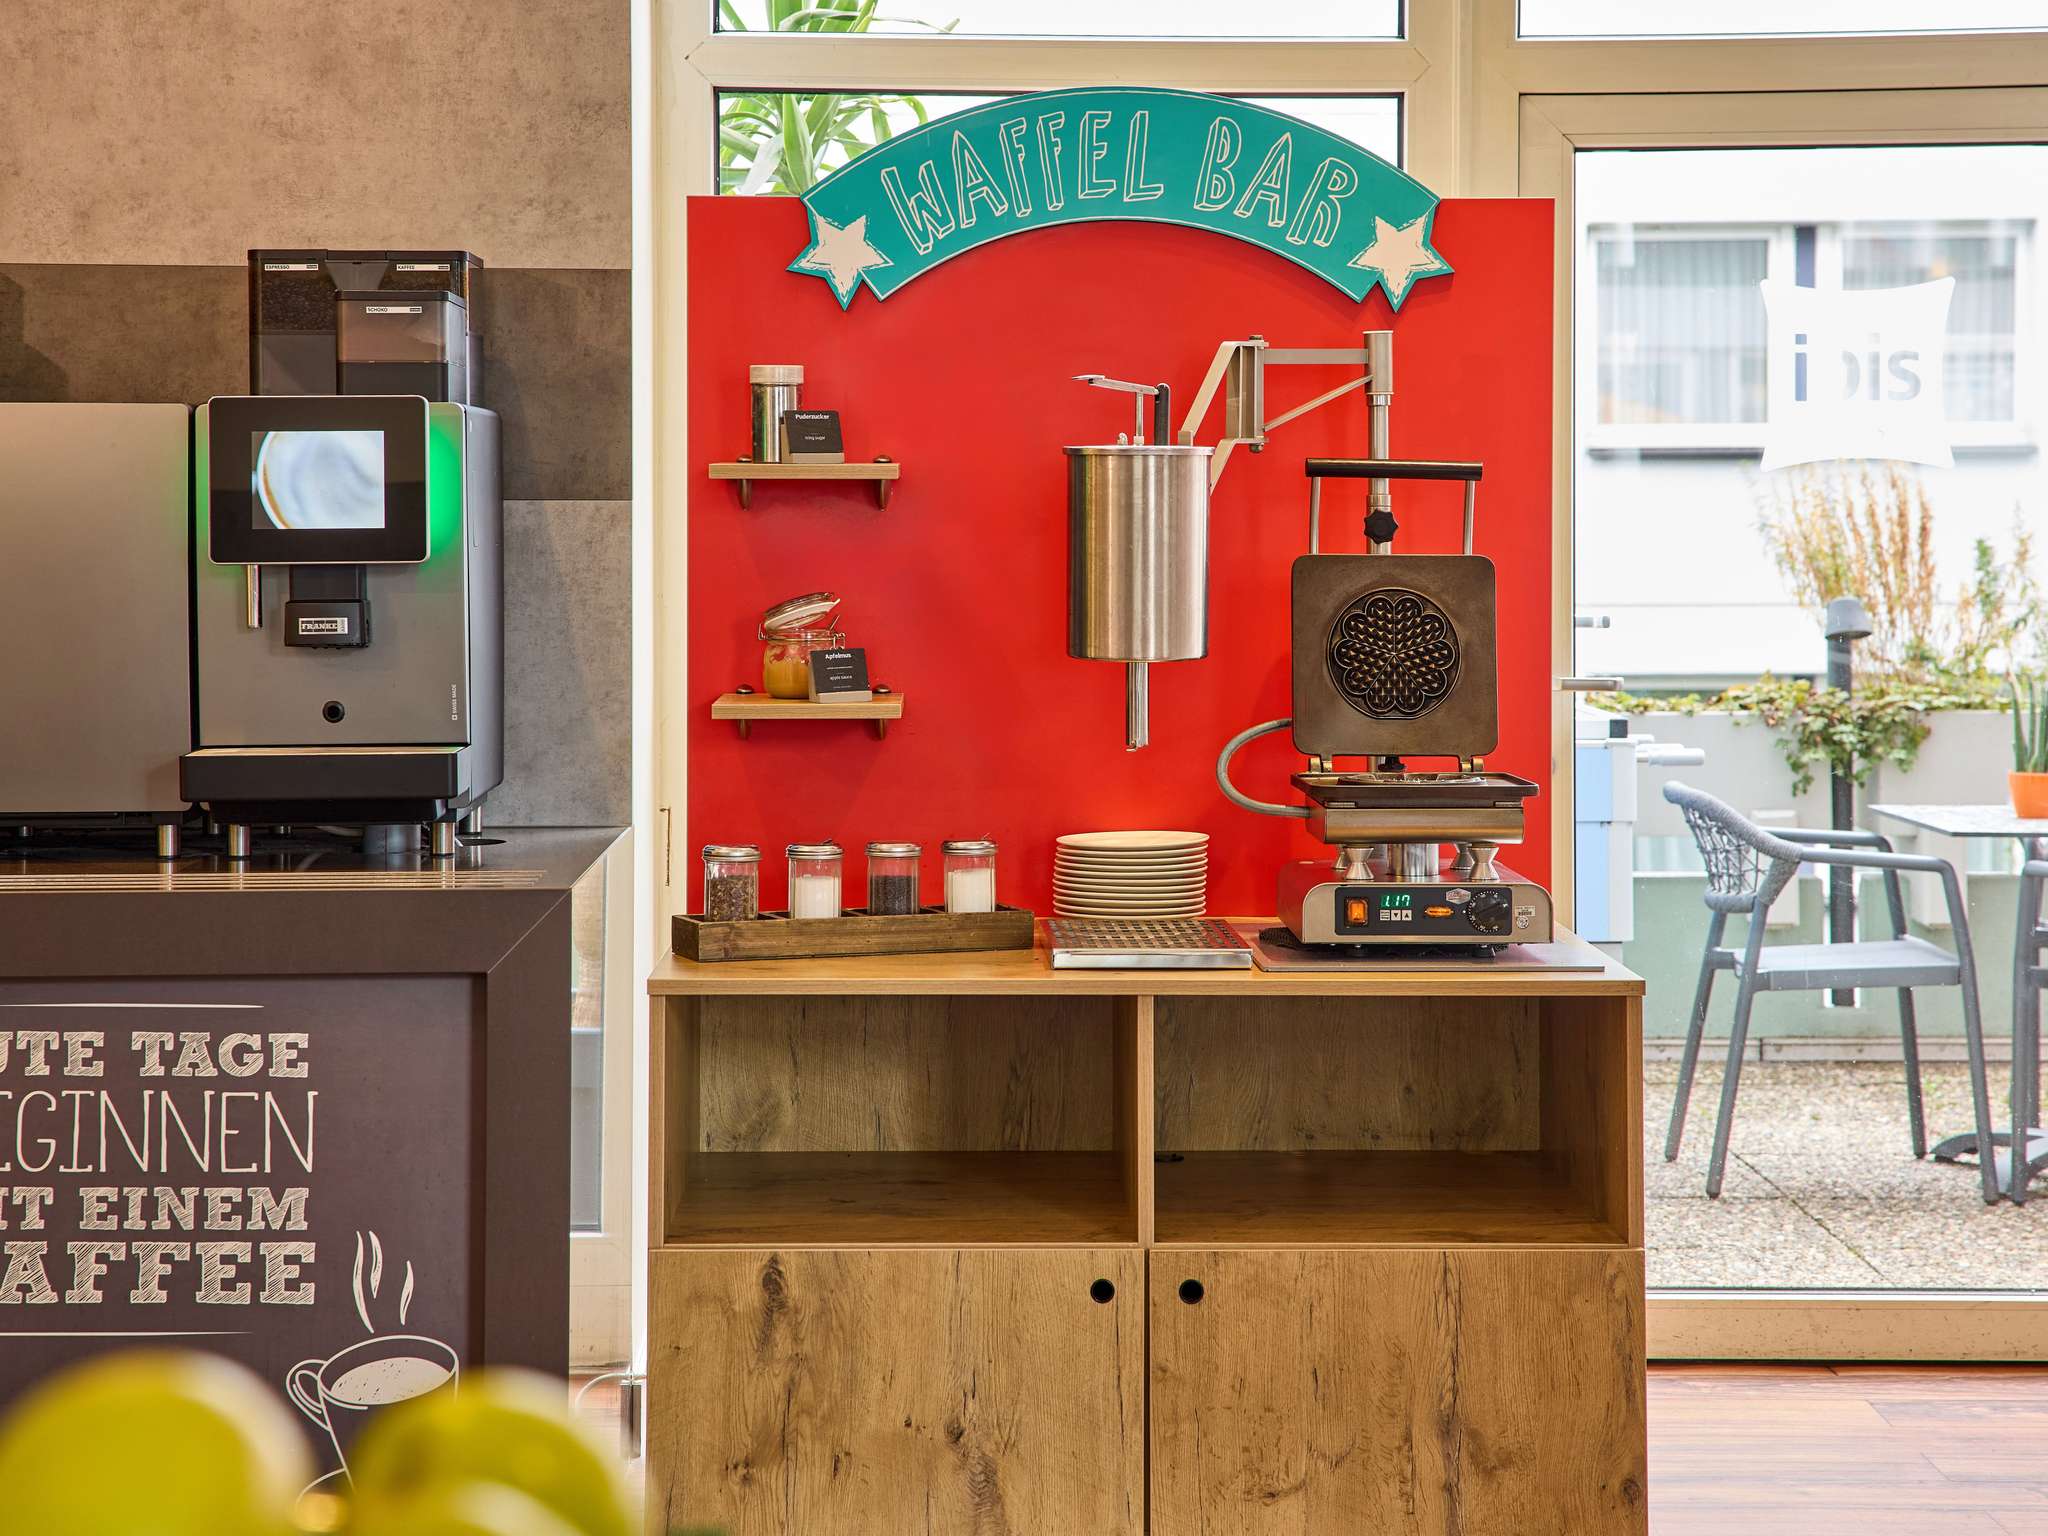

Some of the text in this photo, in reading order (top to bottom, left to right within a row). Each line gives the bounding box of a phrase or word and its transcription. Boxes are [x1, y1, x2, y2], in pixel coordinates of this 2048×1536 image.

[880, 111, 1358, 256] WAFFEL BAR
[301, 622, 338, 630] FRANKE
[825, 652, 852, 660] Apfelmus
[0, 1031, 309, 1078] TE TAGE
[79, 1186, 309, 1231] EINEM
